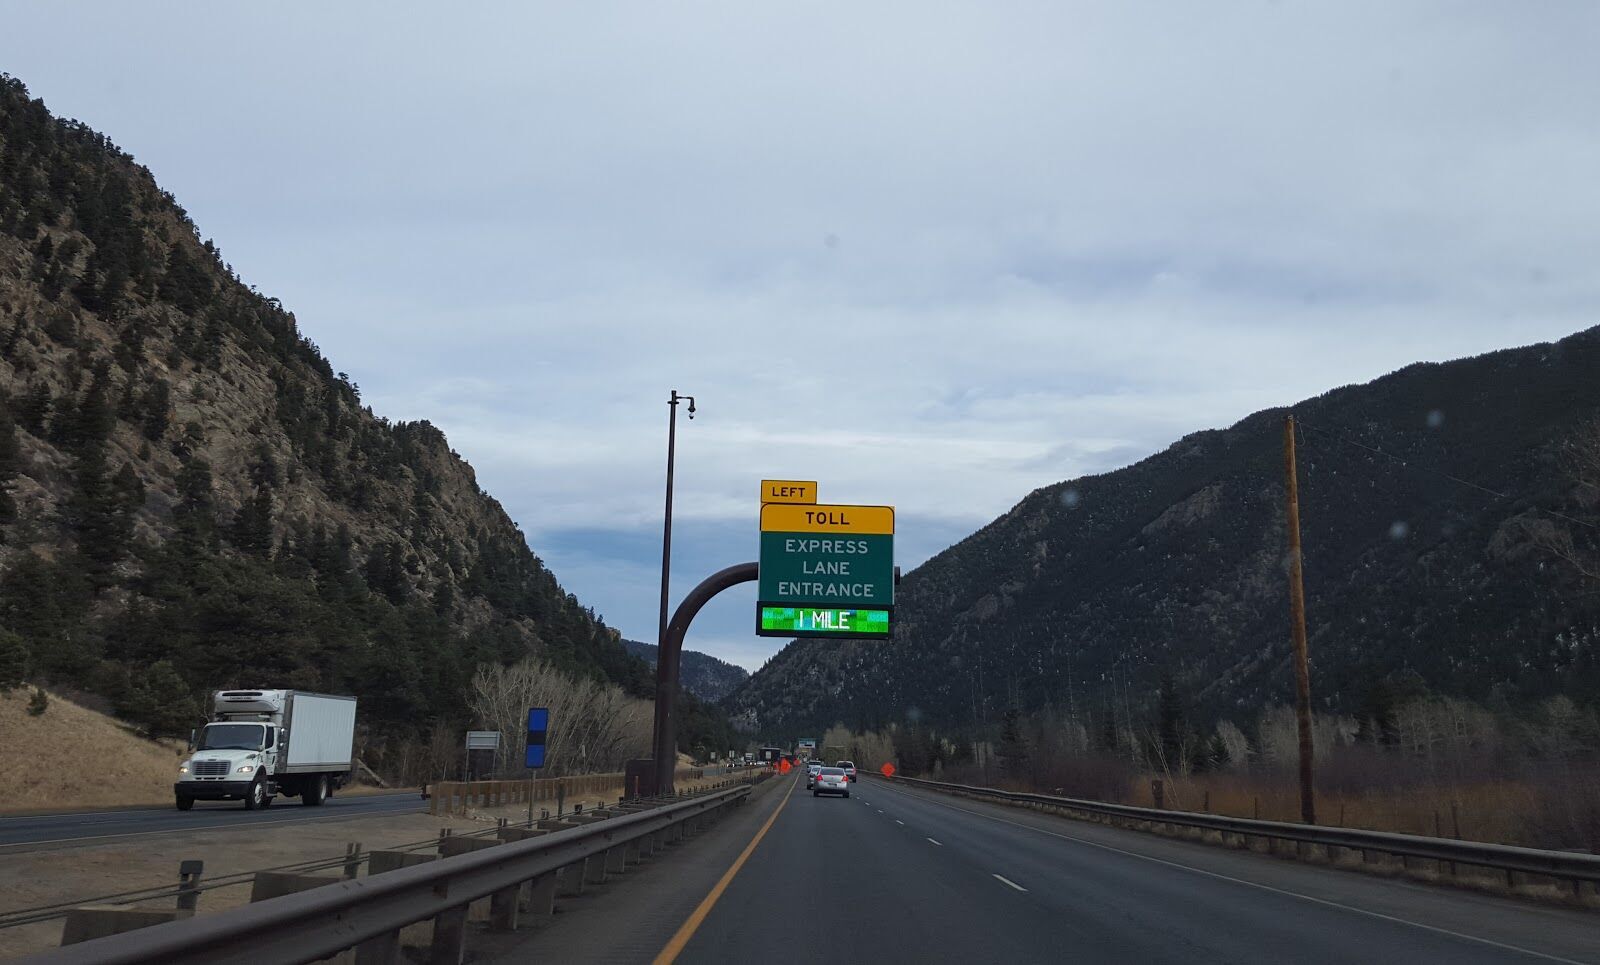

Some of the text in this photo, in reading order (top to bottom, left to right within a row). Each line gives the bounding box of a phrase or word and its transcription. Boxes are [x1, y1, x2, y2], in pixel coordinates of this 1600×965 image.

[772, 486, 805, 497] LEFT
[805, 511, 850, 525] TOLL
[785, 539, 868, 554] EXPRESS
[803, 561, 850, 575] LANE
[778, 582, 874, 597] ENTRANCE
[812, 611, 850, 629] MILE
